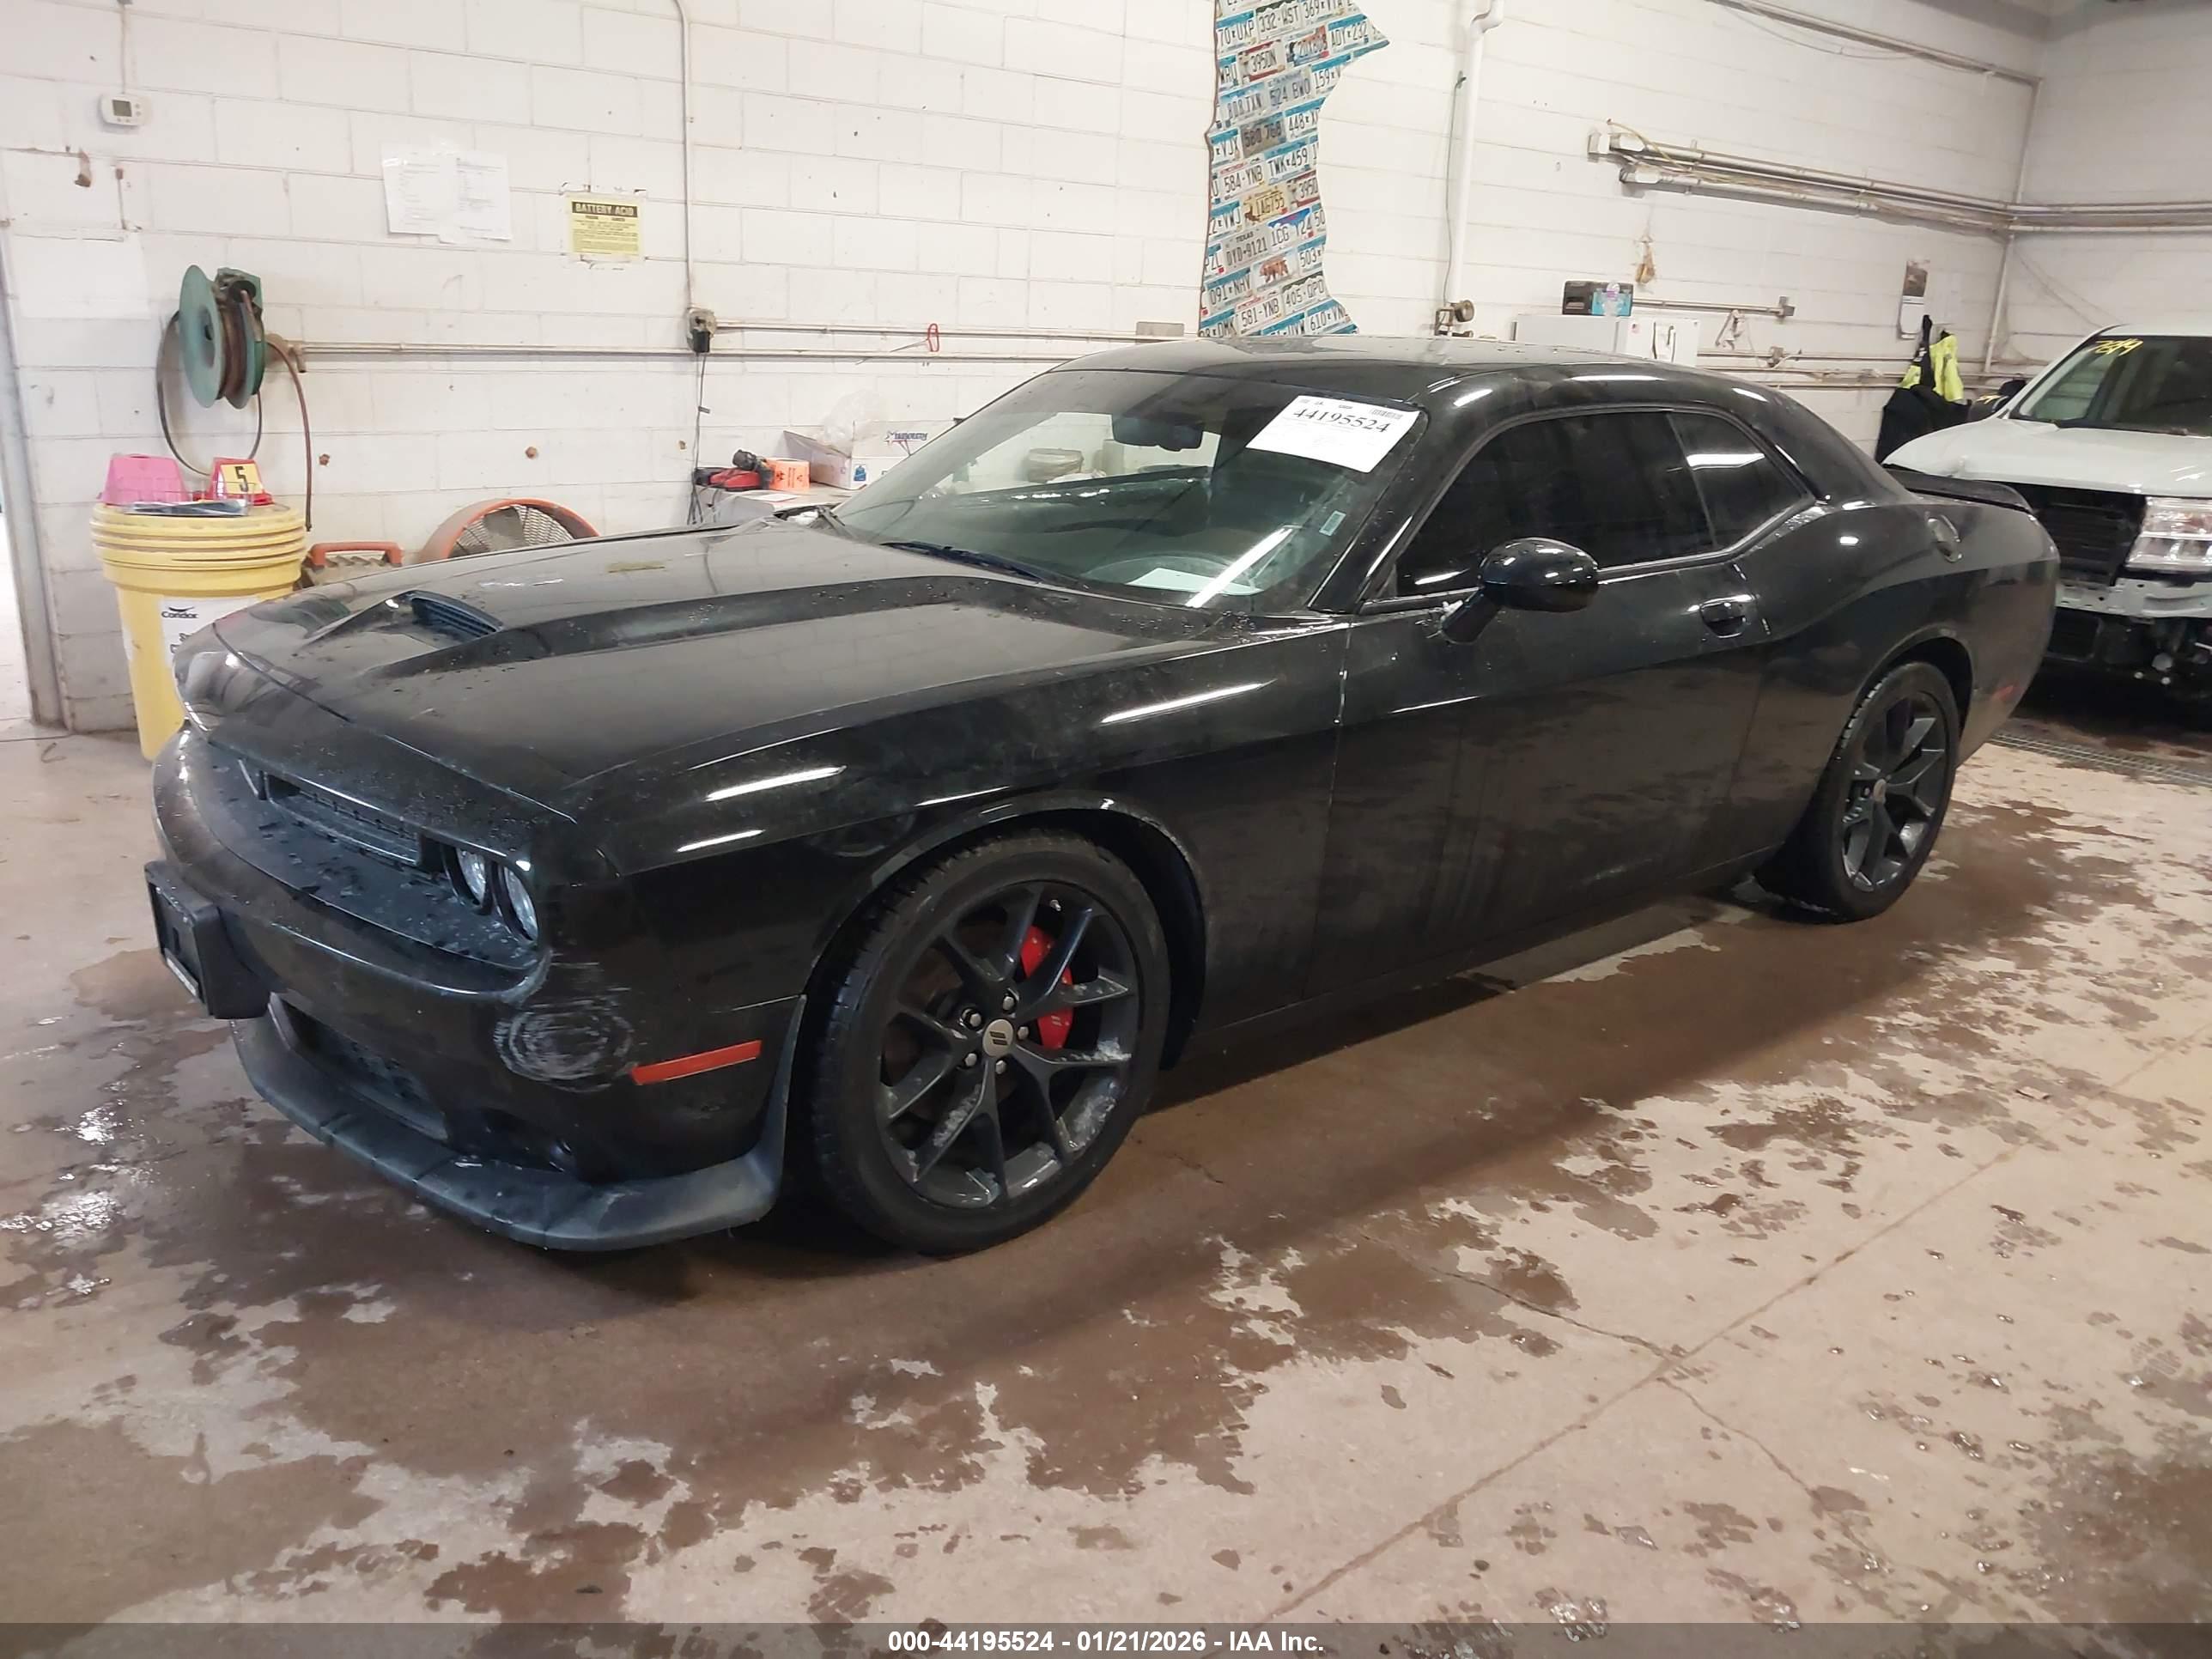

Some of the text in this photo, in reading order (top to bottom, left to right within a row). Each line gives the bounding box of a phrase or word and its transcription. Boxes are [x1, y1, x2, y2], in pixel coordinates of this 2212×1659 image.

[575, 204, 635, 216] BATTERY ACID
[1293, 408, 1391, 434] 44195524
[234, 465, 249, 492] 5
